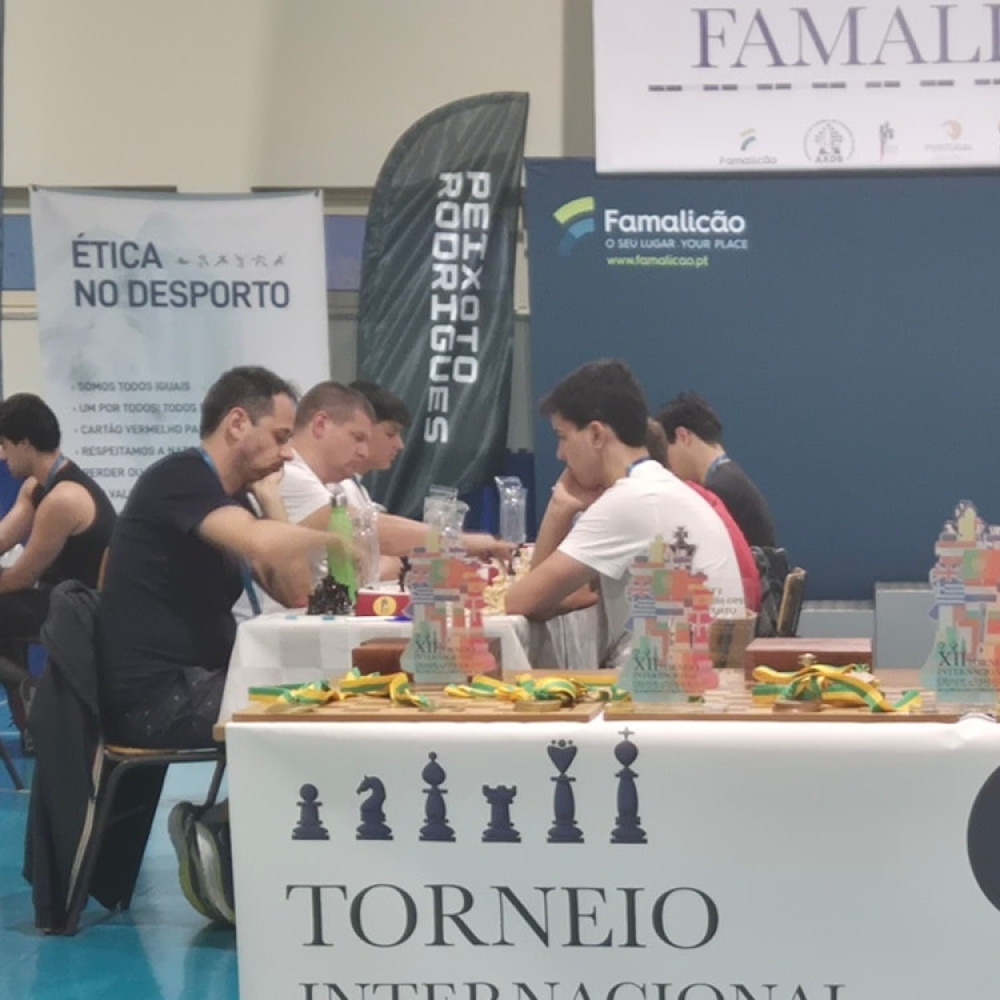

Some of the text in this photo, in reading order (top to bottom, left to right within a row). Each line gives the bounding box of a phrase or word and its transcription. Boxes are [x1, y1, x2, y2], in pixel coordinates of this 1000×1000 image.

[604, 208, 747, 234] Famalicão
[71, 232, 163, 269] ÉTICA
[605, 238, 749, 249] O SEU LUGAR YOUR PLACE
[606, 255, 709, 267] www.famalicao.pt
[452, 171, 492, 384] PEIXOTO
[74, 279, 290, 308] NO DESPORTO
[424, 171, 464, 444] RODRIGUES
[118, 381, 152, 392] TODOS
[98, 403, 120, 413] POR
[163, 403, 197, 413] TODOS
[125, 424, 182, 434] VERMELHO
[81, 446, 155, 457] RESPEITAMOS
[286, 883, 720, 950] TORNEIO
